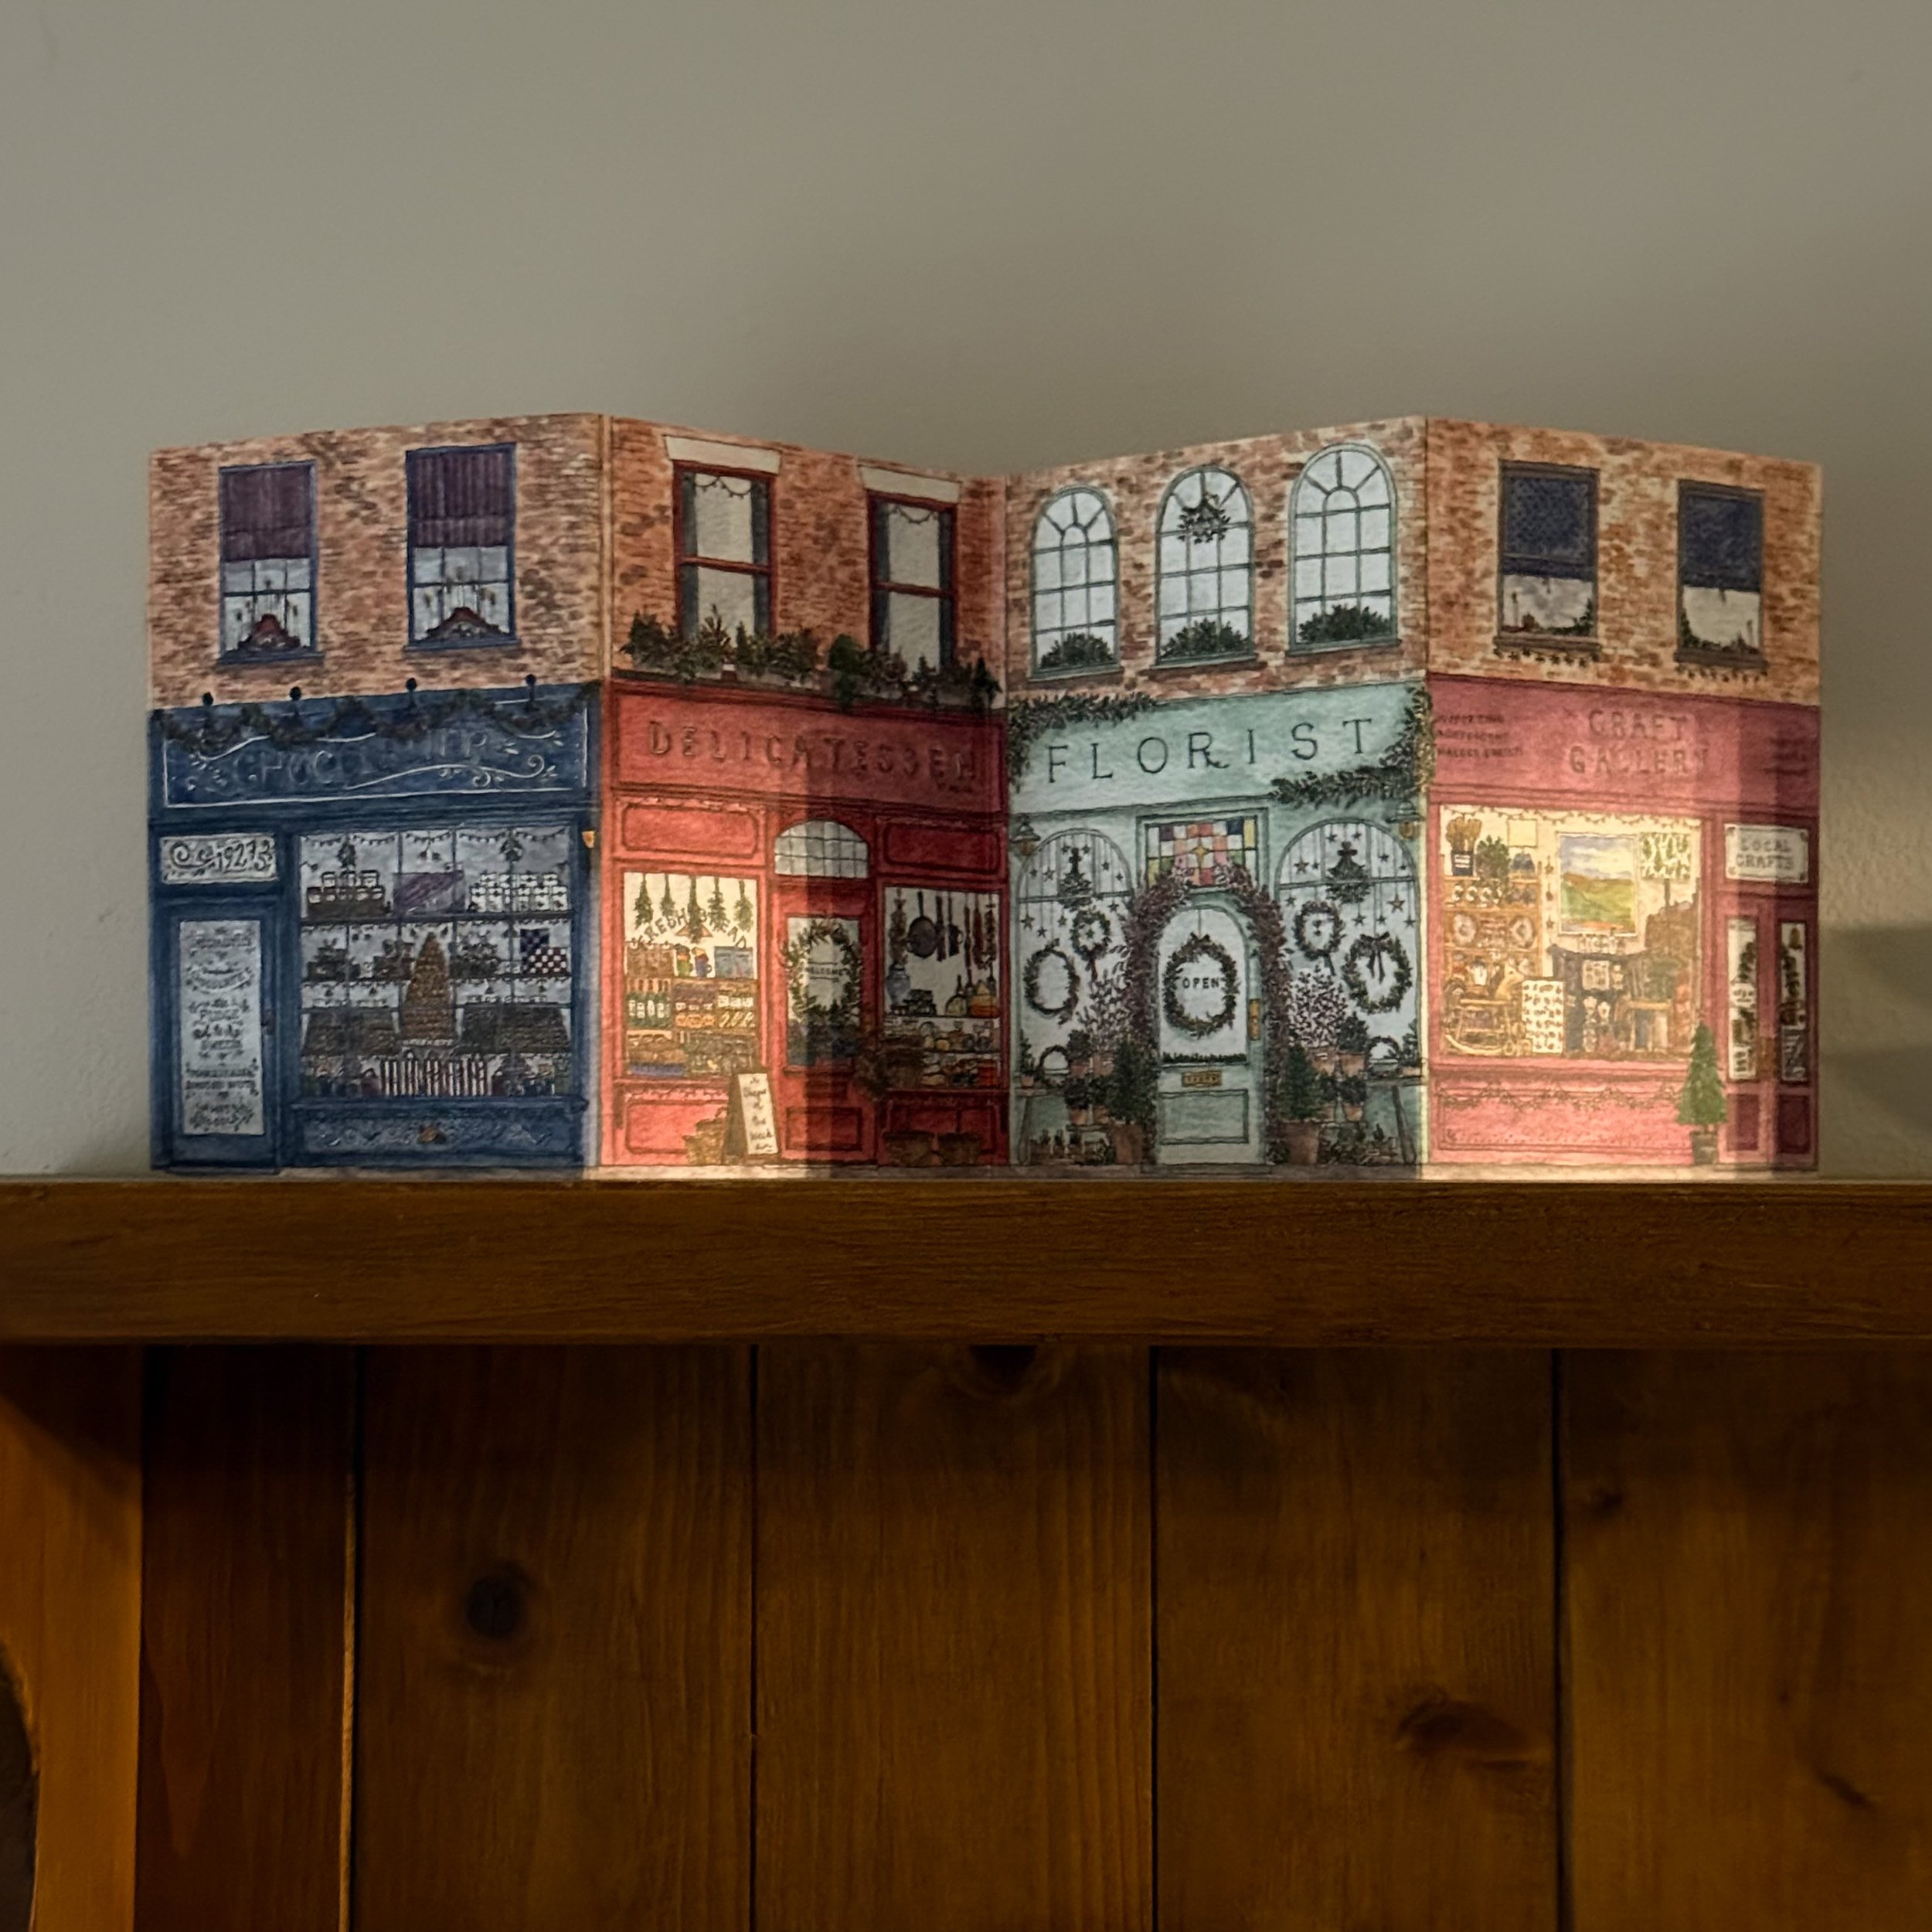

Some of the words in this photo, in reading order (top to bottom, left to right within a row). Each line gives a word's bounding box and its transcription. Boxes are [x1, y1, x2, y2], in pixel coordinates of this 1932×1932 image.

[1587, 708, 1687, 742] CRAFT
[648, 719, 977, 779] DELICATESSEN
[1047, 718, 1372, 784] FLORIST
[1569, 740, 1709, 775] GALLERY
[1736, 853, 1794, 870] CRAFTS
[1740, 837, 1792, 852] LOCAL
[1182, 977, 1219, 989] OPEN
